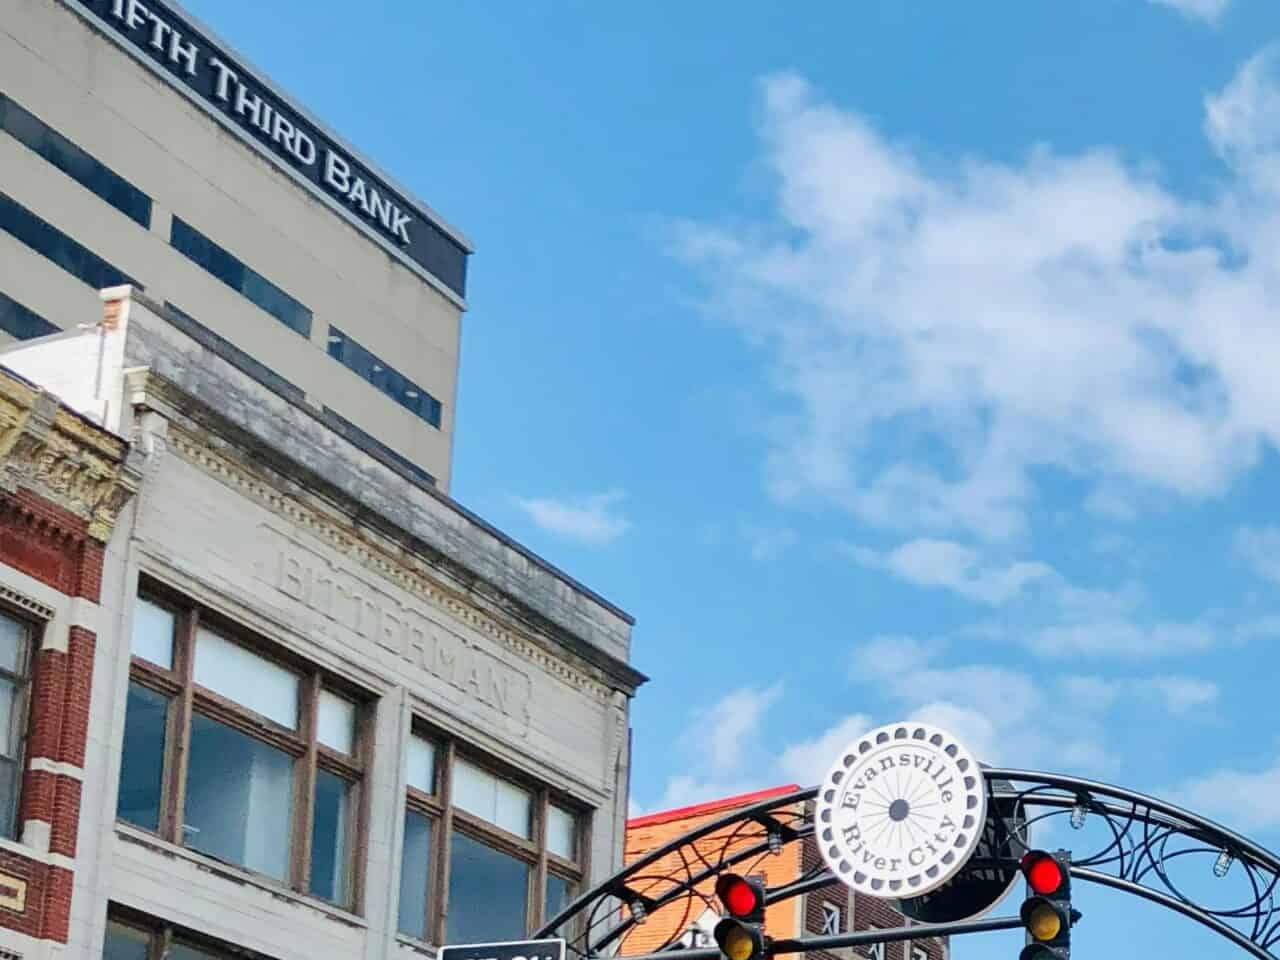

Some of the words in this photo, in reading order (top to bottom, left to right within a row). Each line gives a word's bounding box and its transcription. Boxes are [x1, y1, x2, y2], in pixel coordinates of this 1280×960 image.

[112, 0, 198, 76] IFTH
[208, 57, 317, 168] THIRD
[325, 149, 413, 245] BANK
[841, 753, 954, 811] Evansville
[842, 822, 902, 872] River
[908, 815, 957, 866] City
